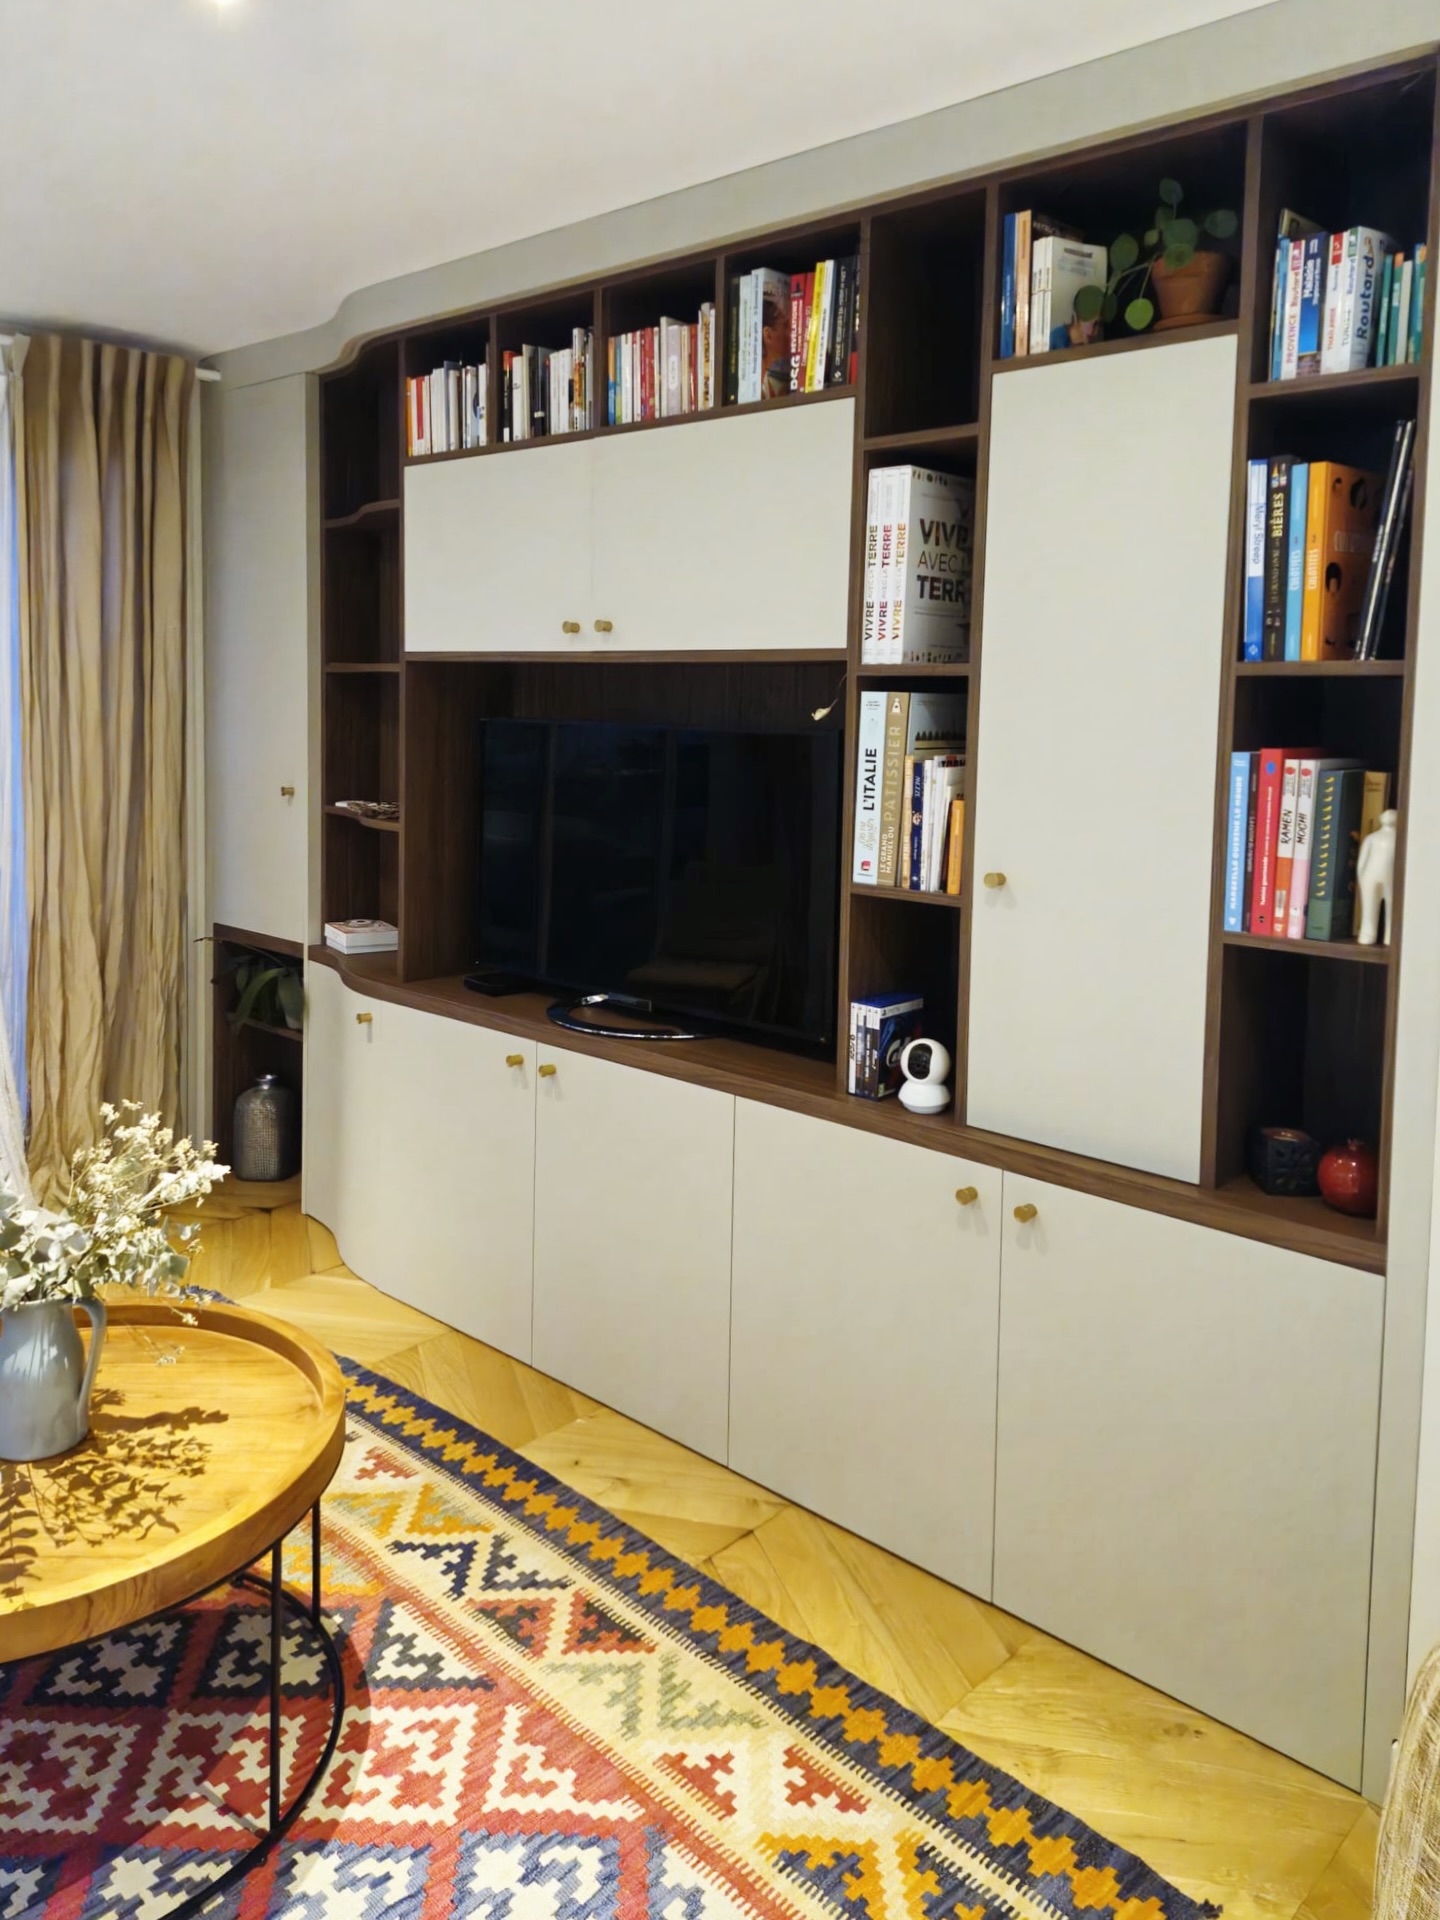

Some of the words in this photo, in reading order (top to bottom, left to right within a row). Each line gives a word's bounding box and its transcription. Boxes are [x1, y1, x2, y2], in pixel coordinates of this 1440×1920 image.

[1290, 271, 1300, 307] Routard
[1355, 255, 1374, 340] Routard
[1286, 313, 1297, 363] PROVENCE
[1251, 504, 1265, 531] Meryl
[1269, 492, 1284, 537] BIÈRES
[868, 525, 878, 567] TERRE
[881, 524, 892, 568] TERRE
[895, 523, 906, 567] TERRE
[920, 518, 968, 551] VIVR
[1251, 533, 1264, 565] Streep
[918, 551, 958, 573] AVEC
[917, 575, 965, 602] TERR
[864, 601, 874, 640] VIVRE
[878, 601, 888, 641] VIVRE
[892, 600, 902, 640] VIVRE
[863, 748, 877, 811] L'ITALIE
[1234, 808, 1241, 818] LE
[1280, 809, 1293, 844] RAMEN
[1296, 813, 1307, 844] MOCHI
[888, 826, 894, 838] DU
[880, 863, 886, 873] LE
[886, 840, 894, 873] MANUEL
[1231, 860, 1239, 910] MARSEILLE
